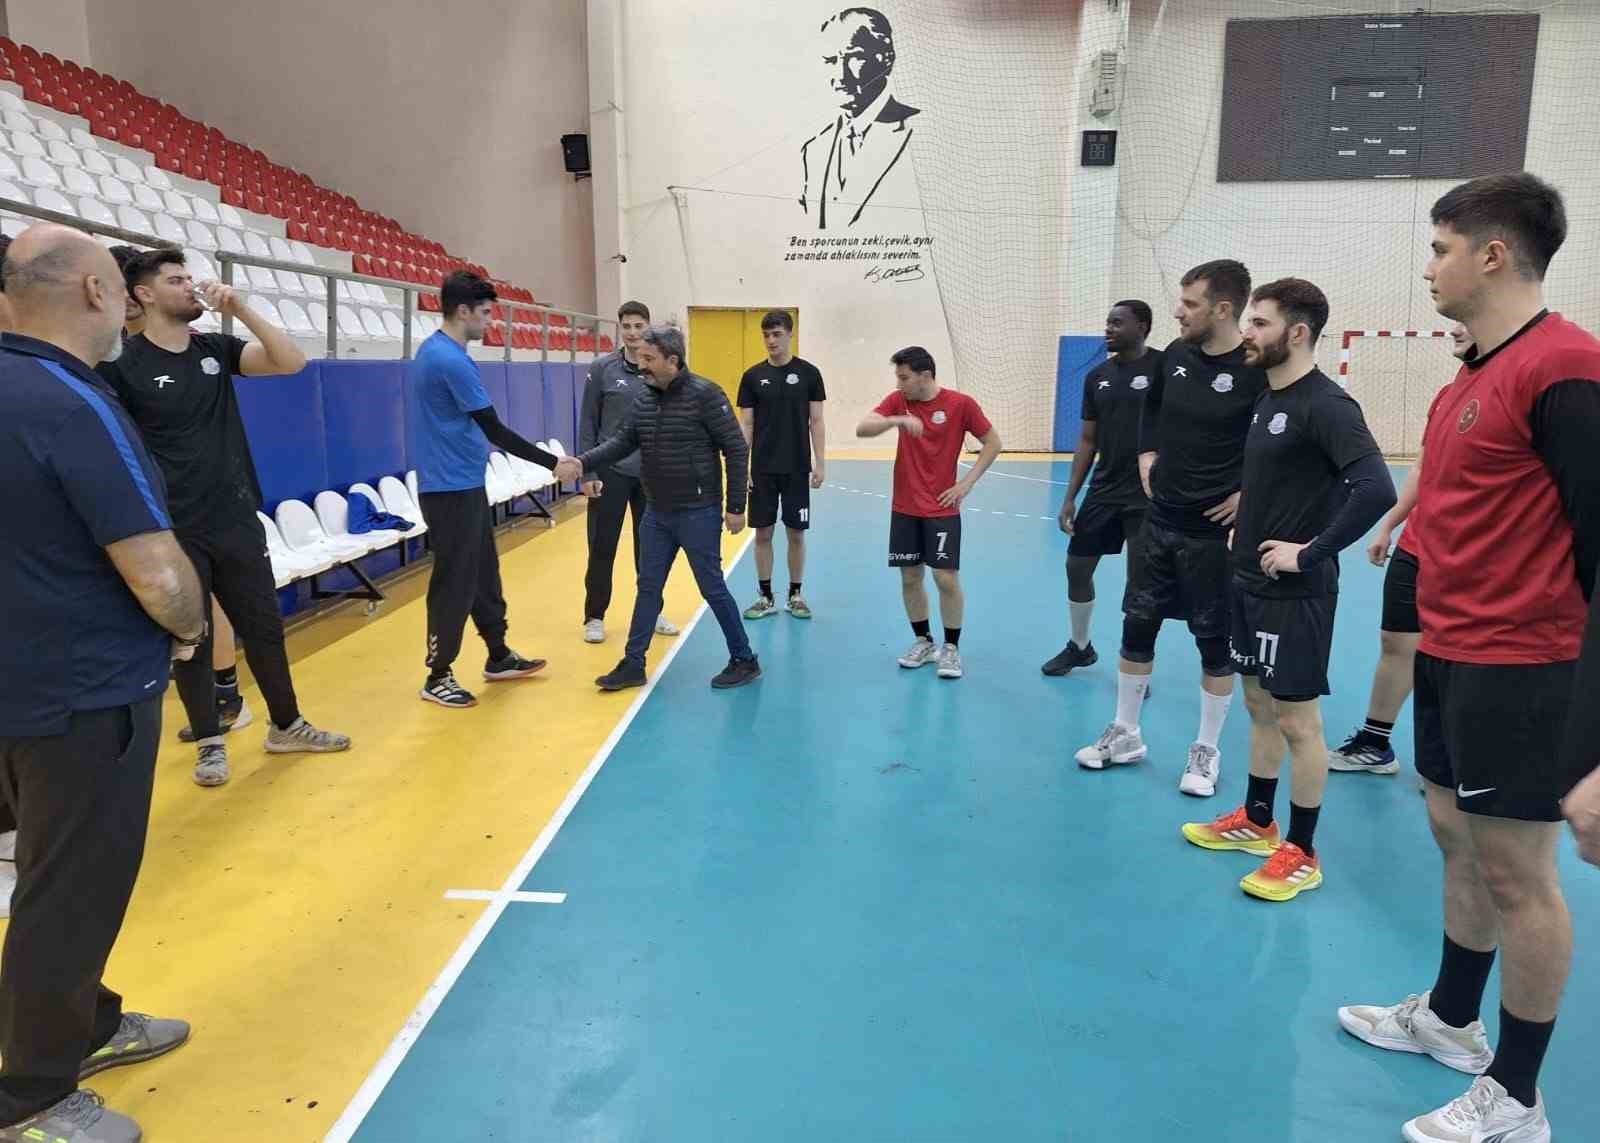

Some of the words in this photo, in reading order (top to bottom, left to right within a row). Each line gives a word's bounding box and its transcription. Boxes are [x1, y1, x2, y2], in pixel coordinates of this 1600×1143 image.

[790, 236, 807, 247] Ben
[784, 250, 828, 261] zamanda
[799, 508, 808, 522] 11
[936, 532, 948, 552] 7
[1256, 631, 1280, 666] 11
